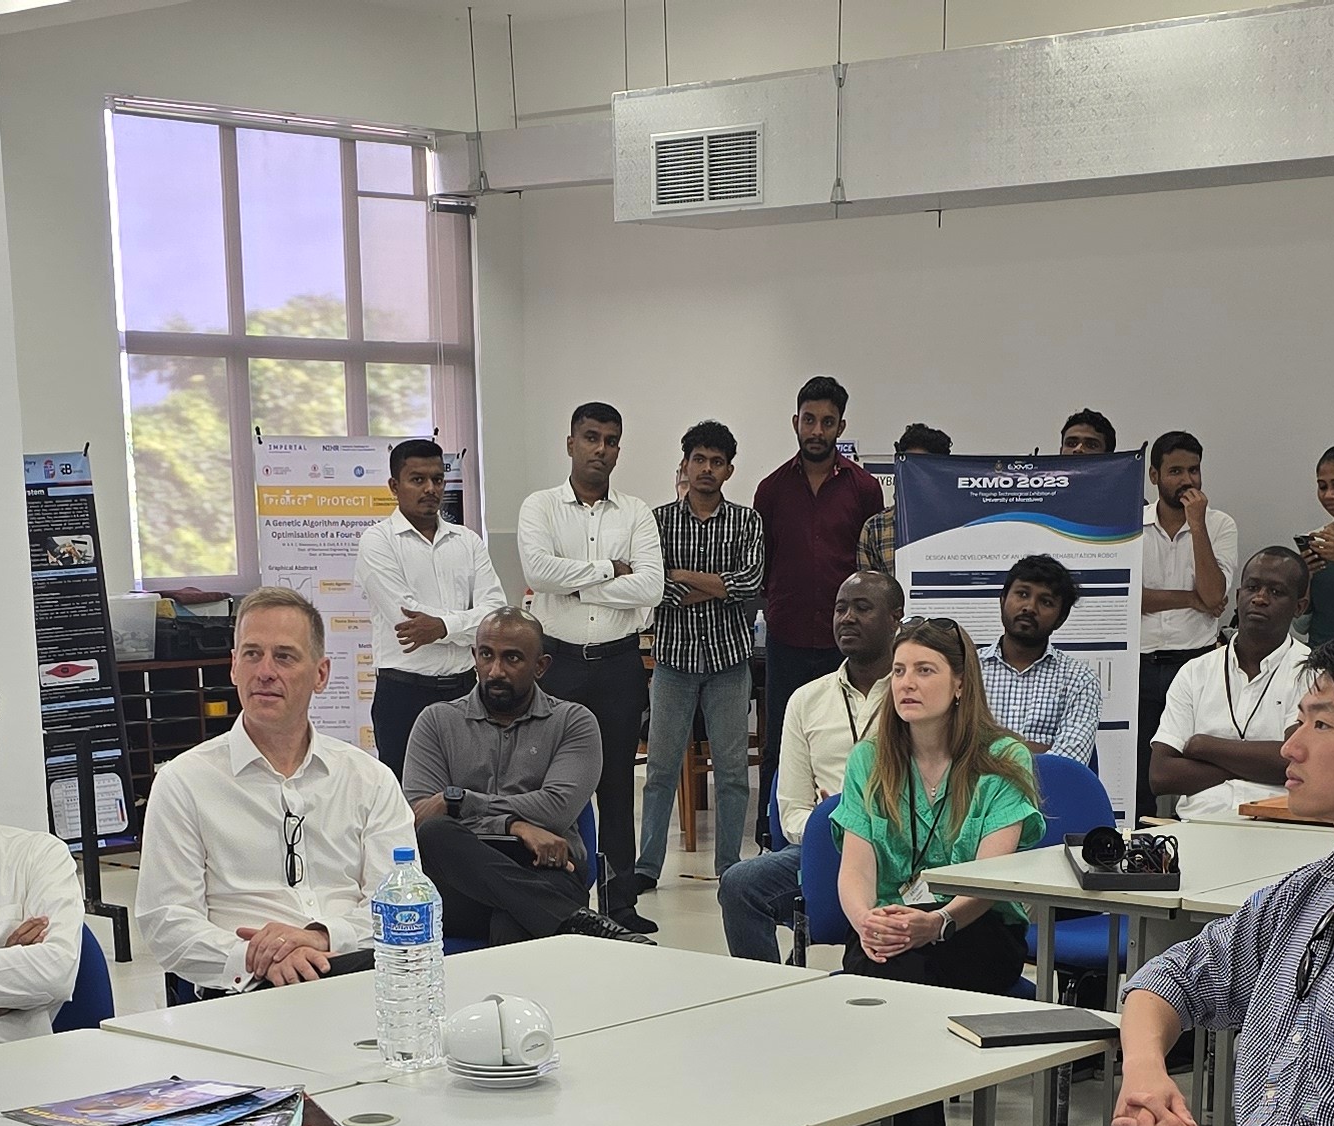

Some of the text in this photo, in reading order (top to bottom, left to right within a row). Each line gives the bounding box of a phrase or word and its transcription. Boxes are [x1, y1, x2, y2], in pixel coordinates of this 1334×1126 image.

[835, 444, 853, 452] TICE
[957, 476, 1070, 489] EXMO 2023
[265, 519, 377, 528] A Genetic Algorithm Approach
[271, 531, 320, 540] Optimisation
